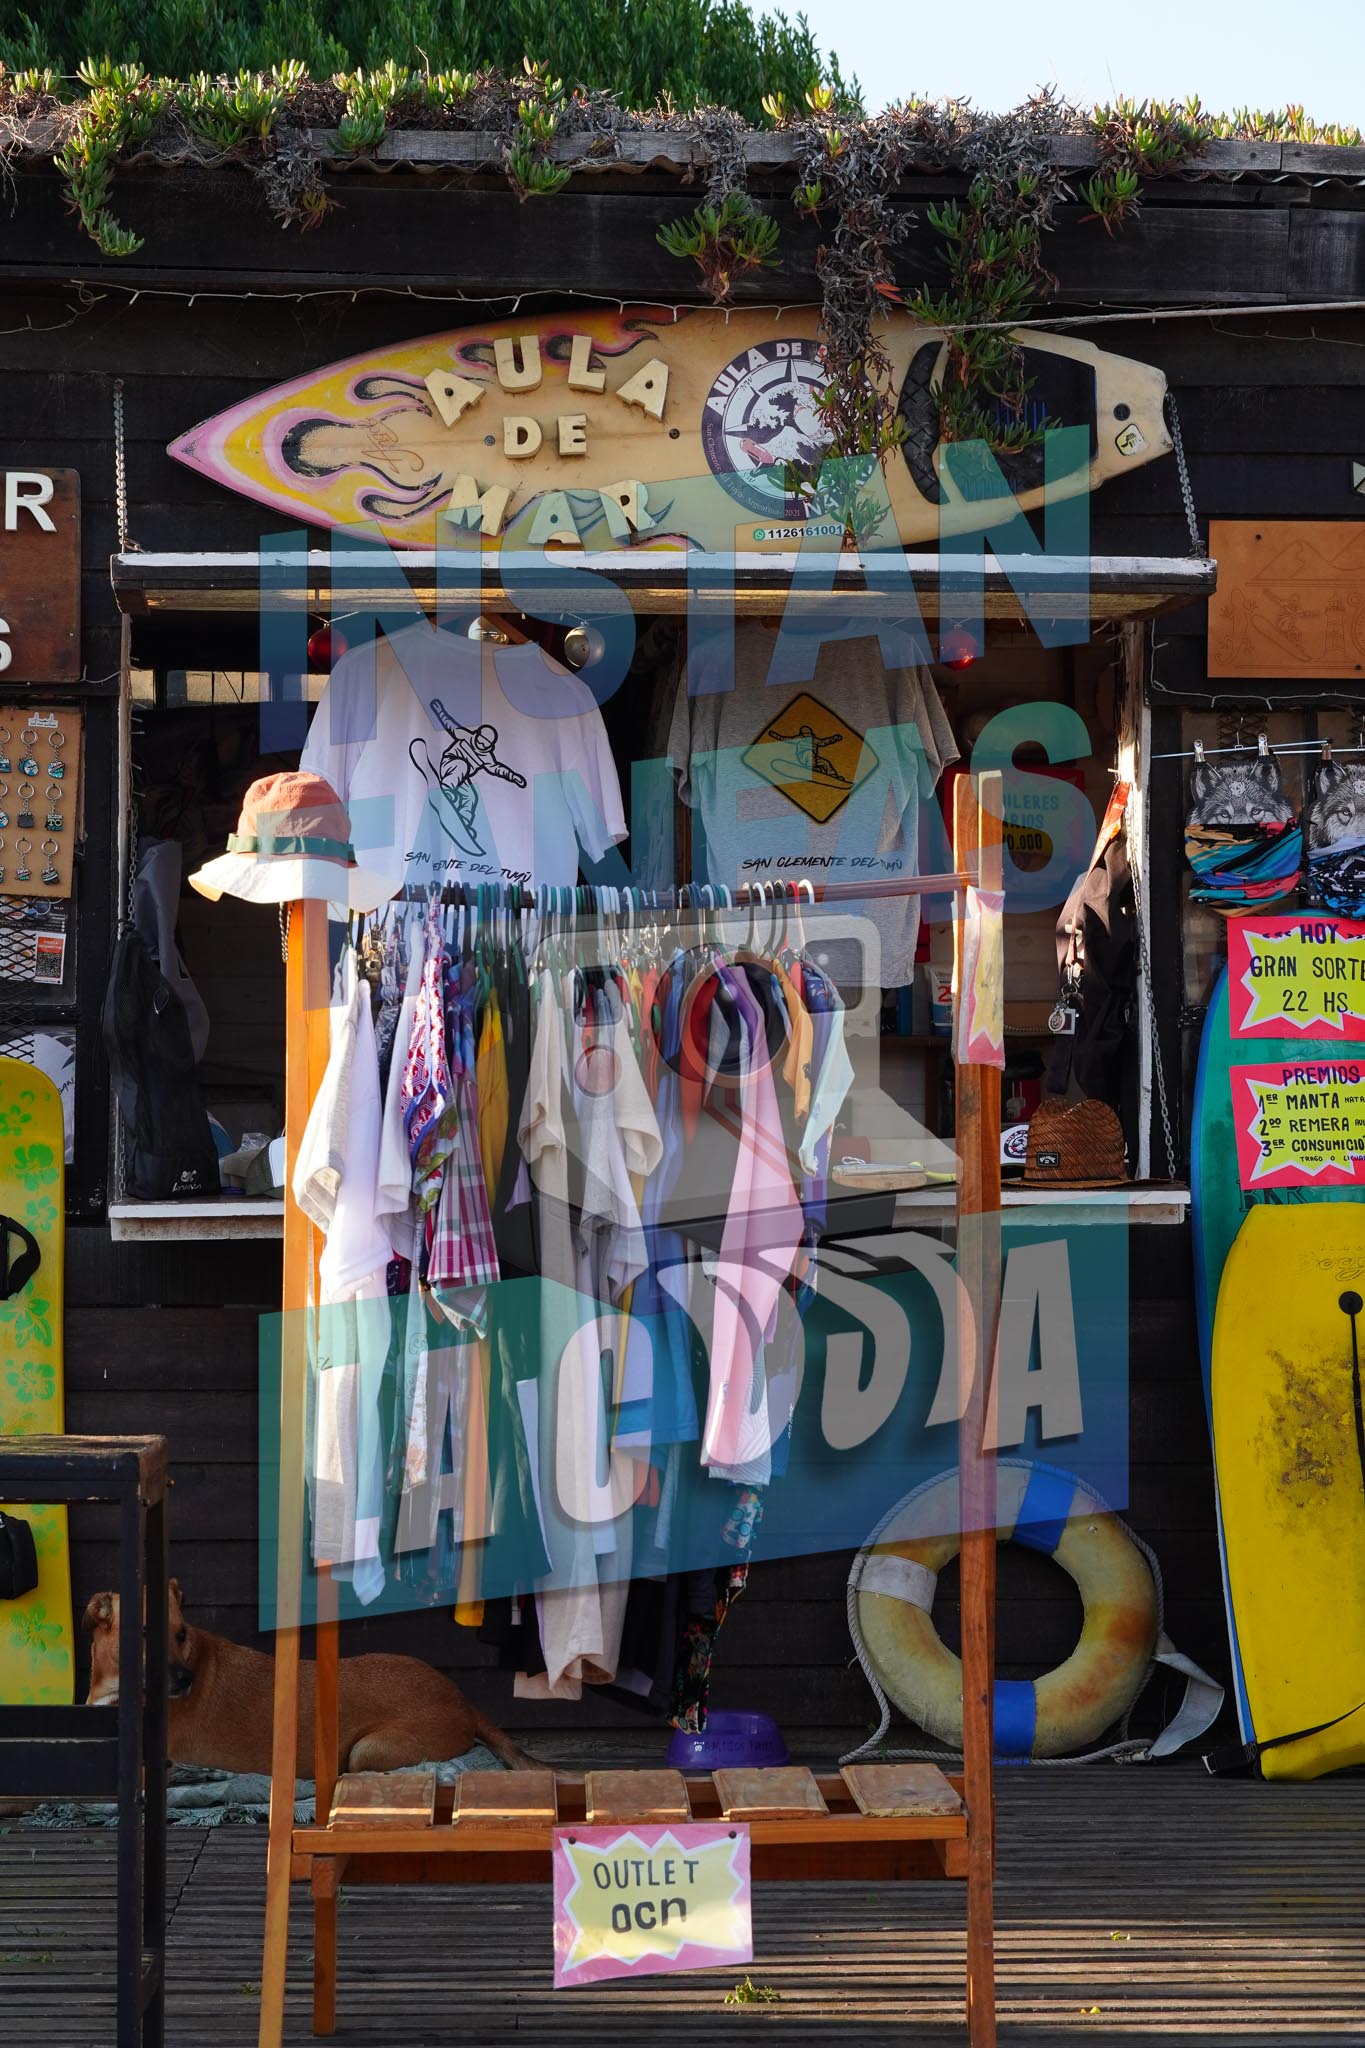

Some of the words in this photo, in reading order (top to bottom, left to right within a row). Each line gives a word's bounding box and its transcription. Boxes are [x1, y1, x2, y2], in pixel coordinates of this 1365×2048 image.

[424, 335, 669, 429] AULA
[706, 347, 769, 417] AULA
[776, 342, 802, 357] DE
[503, 413, 587, 459] DE
[5, 472, 57, 532] R
[443, 474, 657, 545] MAR
[784, 509, 801, 517] 2021
[768, 524, 844, 539] 1126161001
[404, 851, 431, 865] SAN
[468, 863, 498, 876] DEL
[742, 856, 772, 872] SAN
[777, 856, 846, 868] CLEMENTE
[850, 857, 880, 868] DEL
[1299, 923, 1339, 944] HOY
[1250, 955, 1297, 977] GRAN
[1282, 989, 1309, 1012] 22
[1282, 1065, 1361, 1087] PREMIOS
[1286, 1092, 1340, 1110] MANTA
[1289, 1117, 1349, 1133] REMERA
[1300, 1155, 1323, 1163] TRAGO
[593, 1859, 699, 1889] OUTLET
